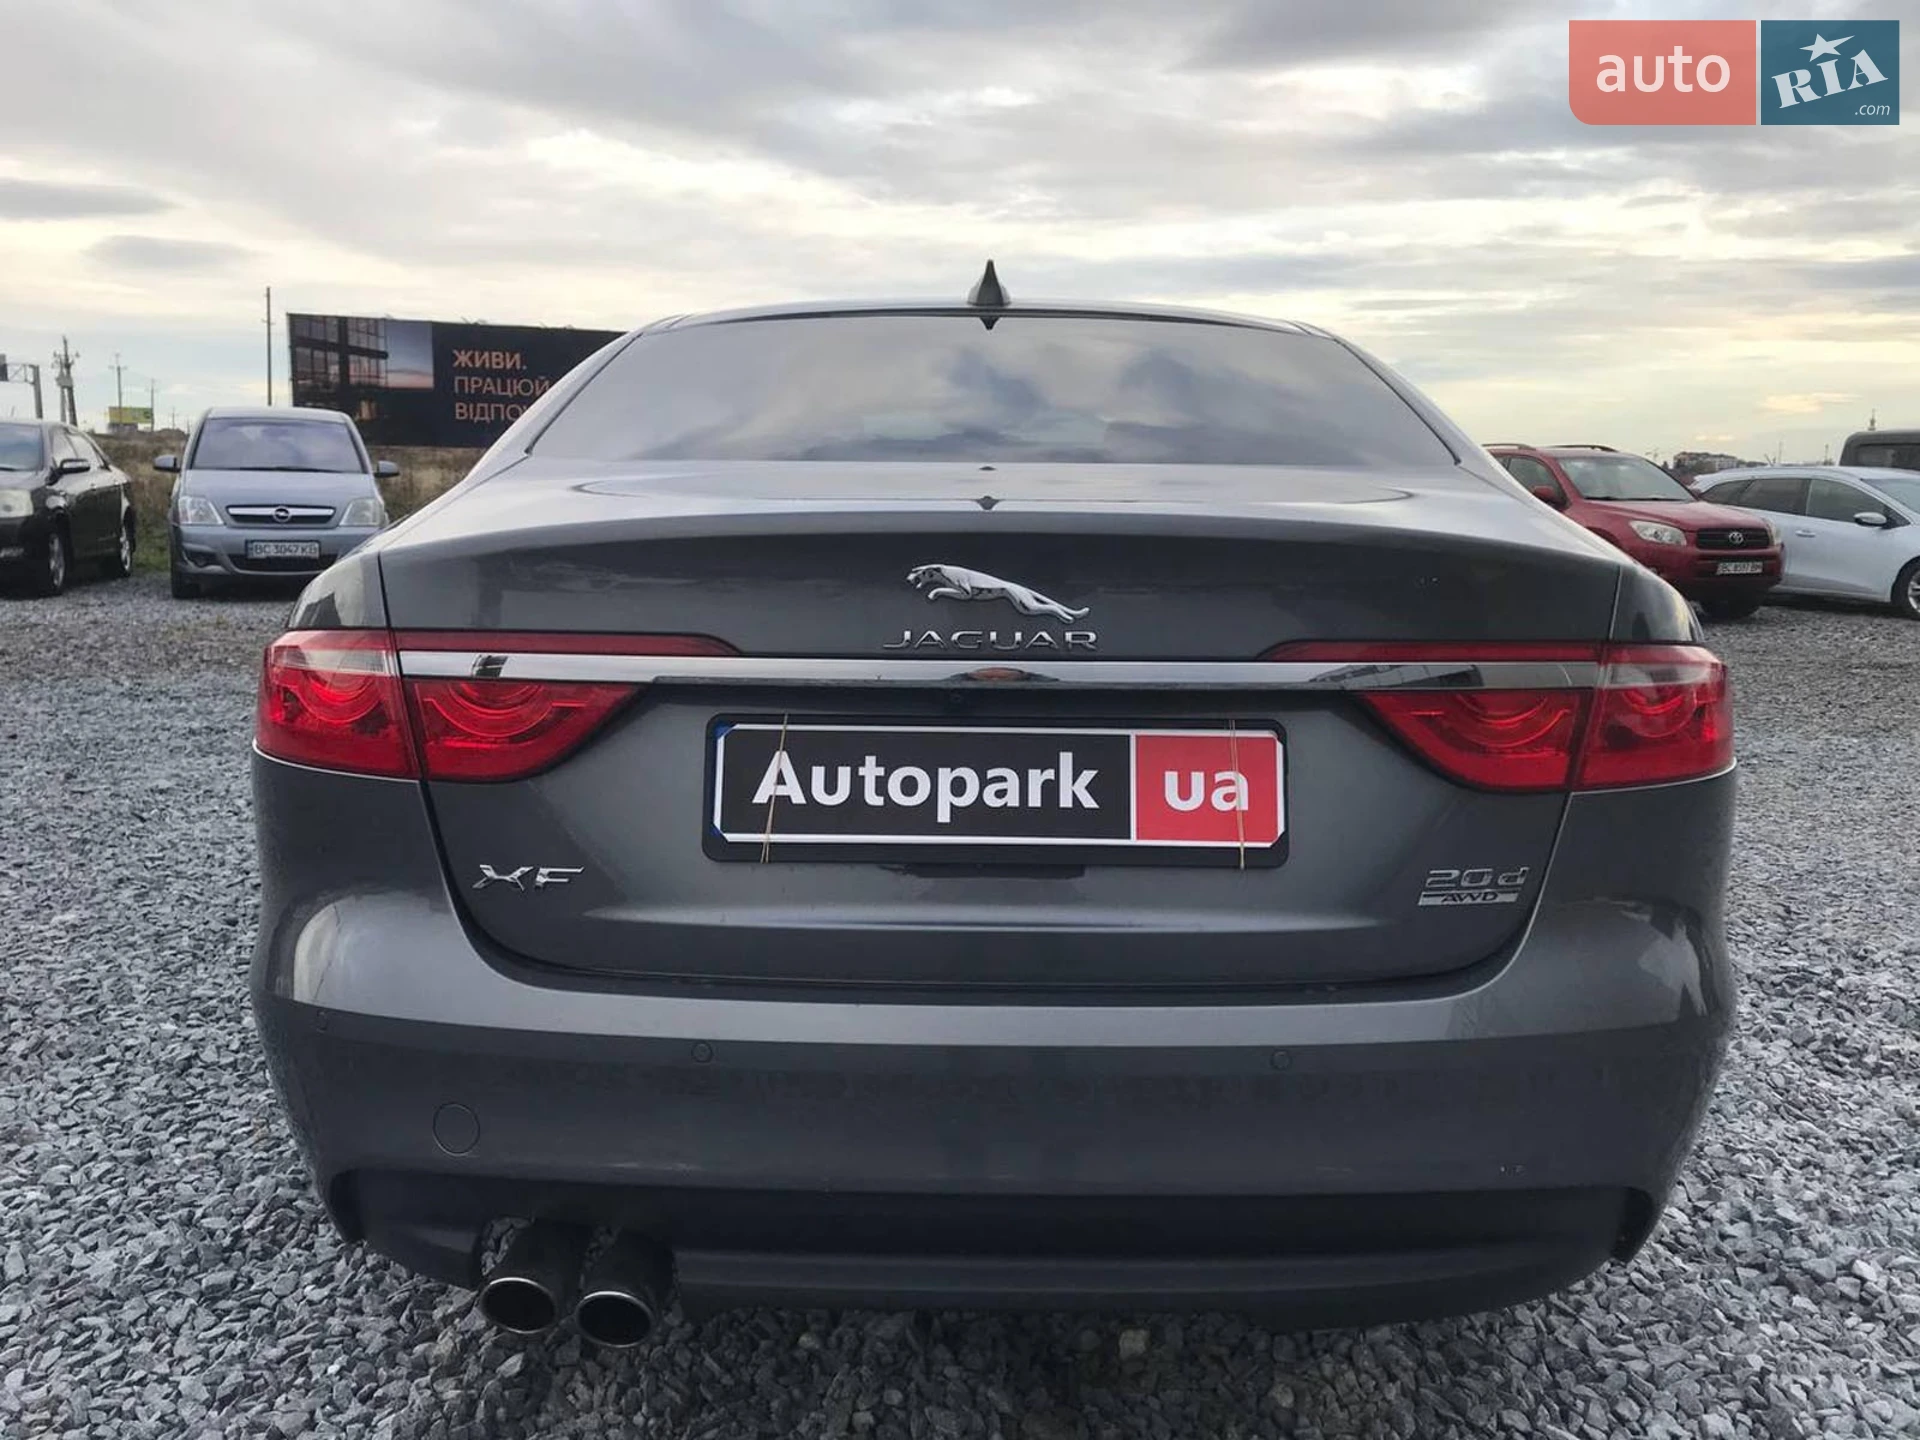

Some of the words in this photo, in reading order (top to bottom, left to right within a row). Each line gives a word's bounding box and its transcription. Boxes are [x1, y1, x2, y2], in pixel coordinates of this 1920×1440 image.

[452, 349, 528, 370] ЖИВИ.
[454, 375, 551, 398] ПРАЦЮЙ
[455, 402, 529, 424] ВІДПО
[883, 630, 1098, 651] JAGUAR
[752, 750, 1099, 823] Autopark
[1164, 767, 1250, 812] ua
[472, 864, 585, 891] XF
[1425, 866, 1530, 888] 20d
[1441, 891, 1499, 903] AWD
